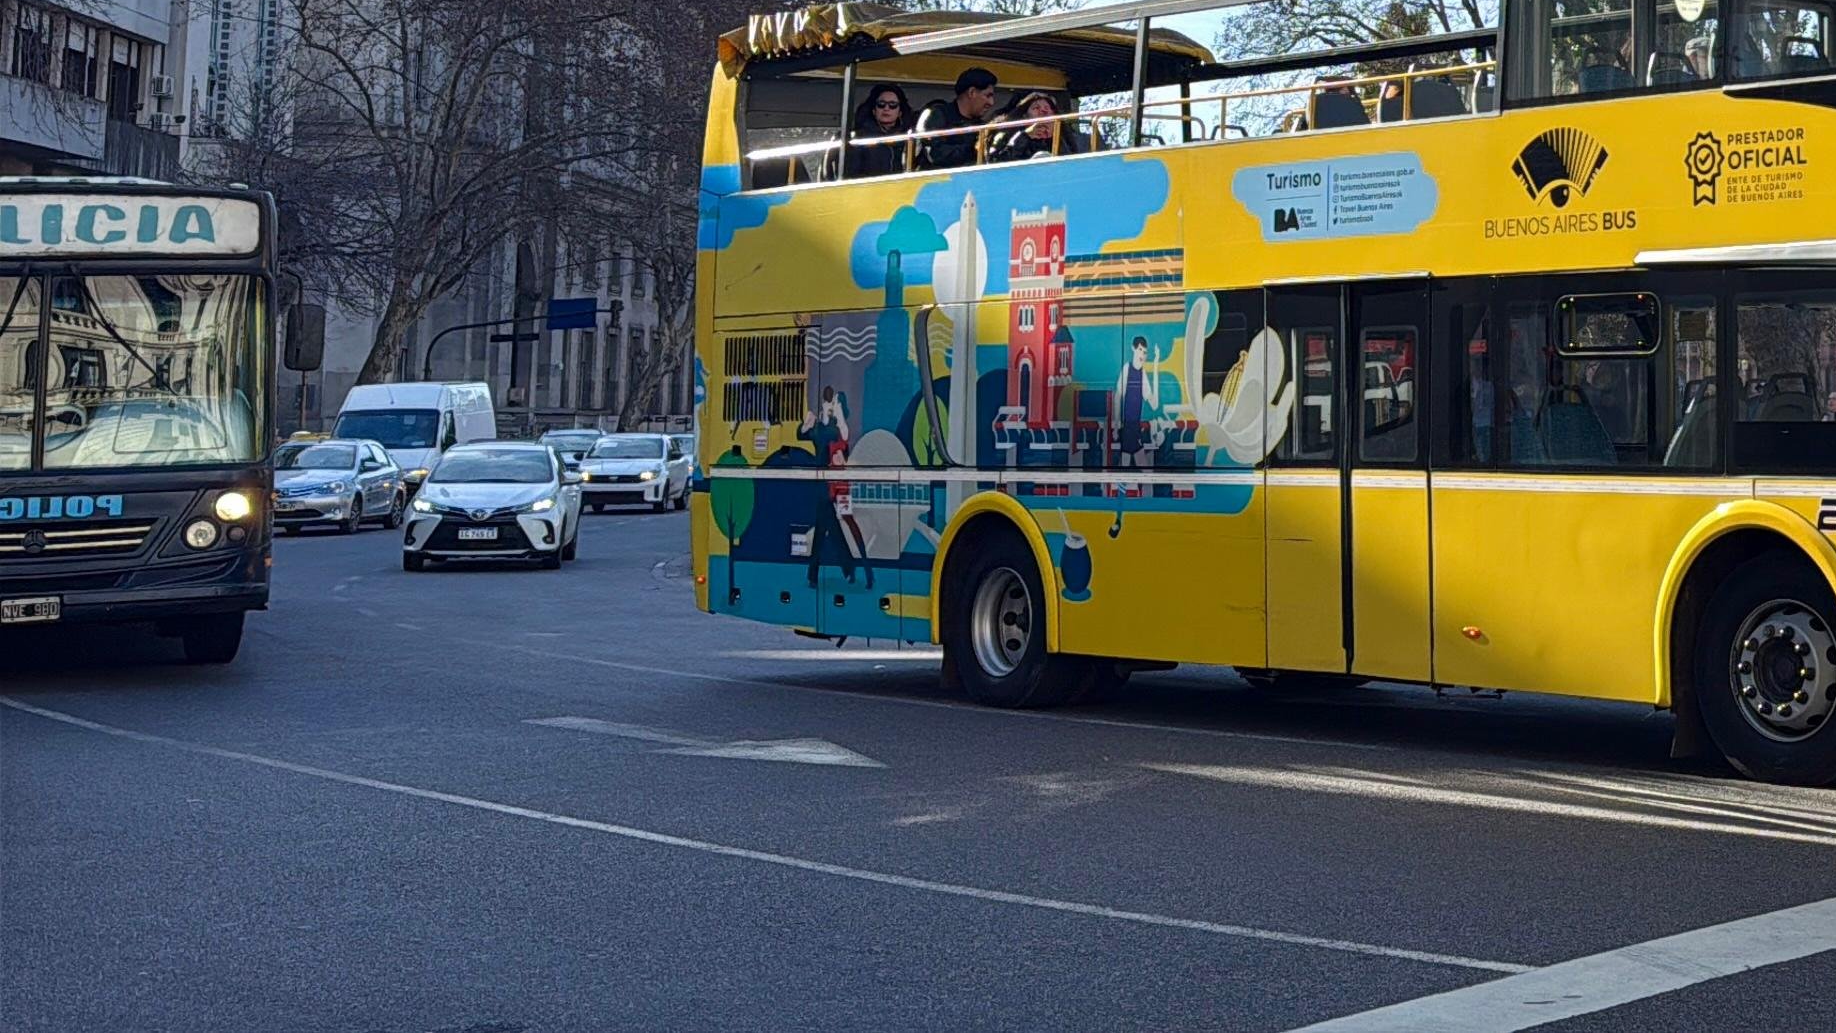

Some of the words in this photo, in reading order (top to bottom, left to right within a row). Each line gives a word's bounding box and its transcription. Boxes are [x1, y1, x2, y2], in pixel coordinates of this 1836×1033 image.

[1727, 128, 1804, 146] PRESTADOR
[1727, 145, 1807, 169] OFICIAL
[1266, 170, 1321, 190] Turismo
[1727, 176, 1748, 185] ENTE
[1751, 175, 1762, 183] DE
[1766, 172, 1803, 182] TURISMO
[1727, 185, 1738, 194] DE
[1741, 184, 1752, 193] LA
[1754, 182, 1787, 192] CIUDAD
[1727, 194, 1738, 203] DE
[1741, 193, 1775, 202] BUENOS
[1778, 190, 1803, 199] AIRES
[1274, 207, 1300, 233] BA
[1485, 216, 1550, 238] BUENOS
[1553, 213, 1598, 234] AIRES
[1603, 210, 1636, 230] BUS
[2, 604, 26, 618] NVE
